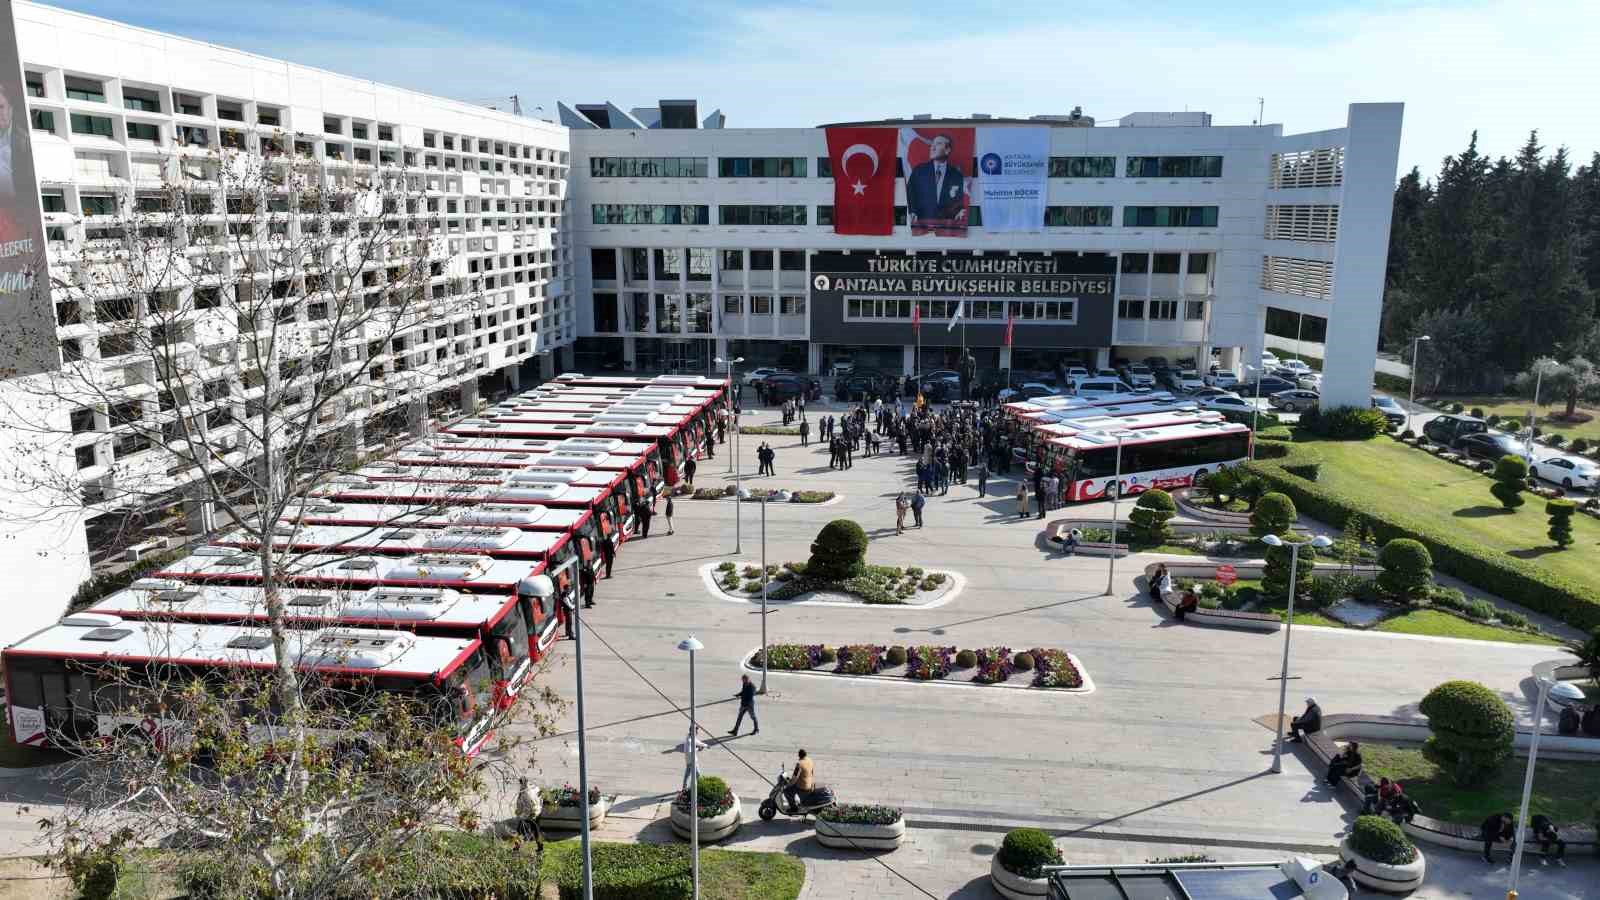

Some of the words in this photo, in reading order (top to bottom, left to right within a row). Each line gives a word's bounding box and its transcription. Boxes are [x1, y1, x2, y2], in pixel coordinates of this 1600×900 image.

[868, 256, 937, 272] TÜRKİYE
[942, 256, 1058, 273] CUMHURİYETİ
[834, 278, 906, 292] ANTALYA
[912, 275, 1016, 294] BÜYÜKŞEHİR
[1021, 276, 1111, 293] BELEDİYESİ
